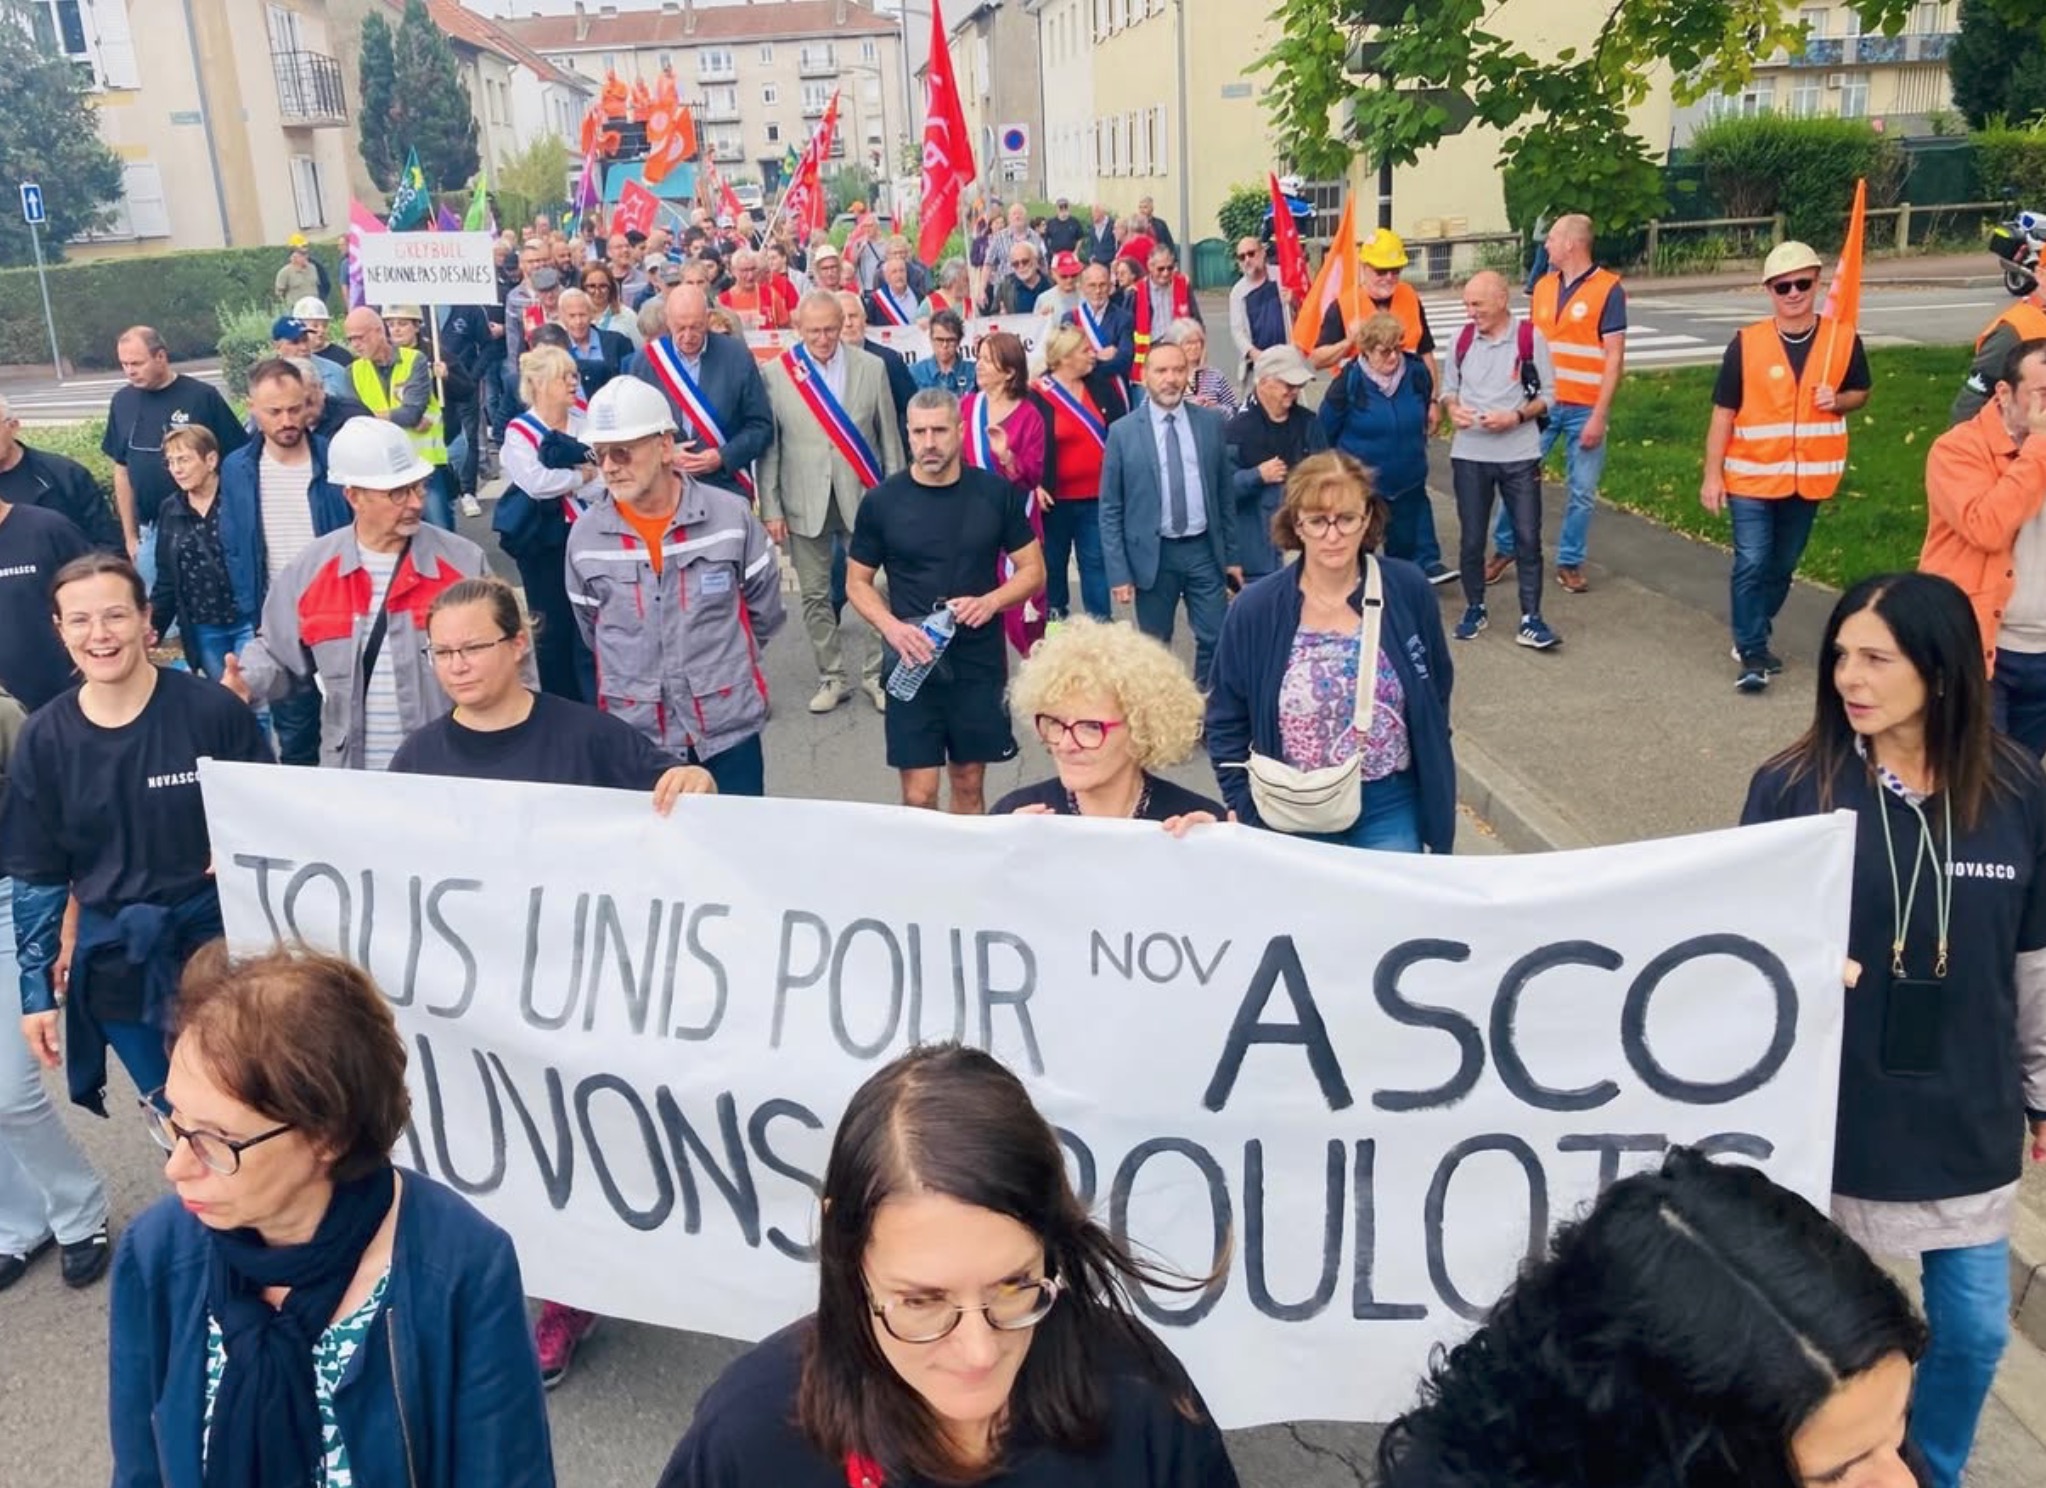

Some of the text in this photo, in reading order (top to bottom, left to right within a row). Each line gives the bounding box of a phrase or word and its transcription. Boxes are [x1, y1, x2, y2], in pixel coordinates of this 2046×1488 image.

[418, 265, 438, 284] PAS
[440, 265, 460, 284] DES
[233, 852, 483, 1019] TOUS
[520, 885, 730, 1042] UNIS
[769, 909, 1045, 1077] POUR
[404, 1032, 1775, 1328] UVONS OULOT
